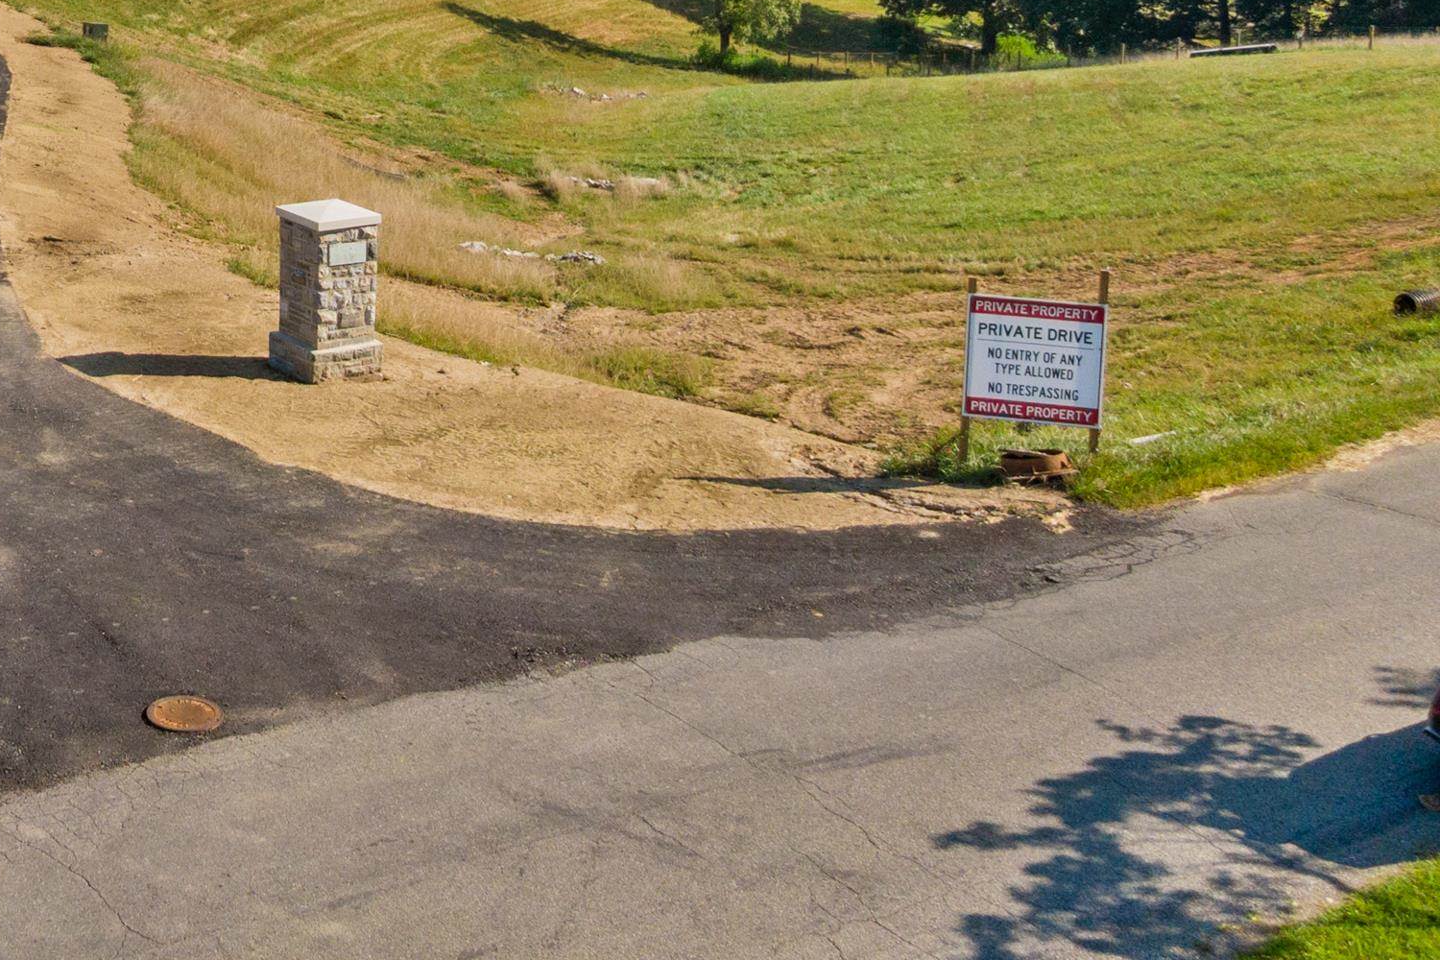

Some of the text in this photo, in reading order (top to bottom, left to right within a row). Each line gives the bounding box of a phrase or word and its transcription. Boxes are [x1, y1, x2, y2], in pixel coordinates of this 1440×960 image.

[976, 300, 1098, 320] PRIVATE PROPERTY
[978, 323, 1093, 344] PRIVATE DRIVE
[988, 348, 1083, 366] NO ENTRY OF ANY
[995, 363, 1073, 380] TYPE ALLOWED
[988, 382, 1079, 401] NO TRESPASSING
[971, 401, 1092, 422] PRIVATE PROPERTY
